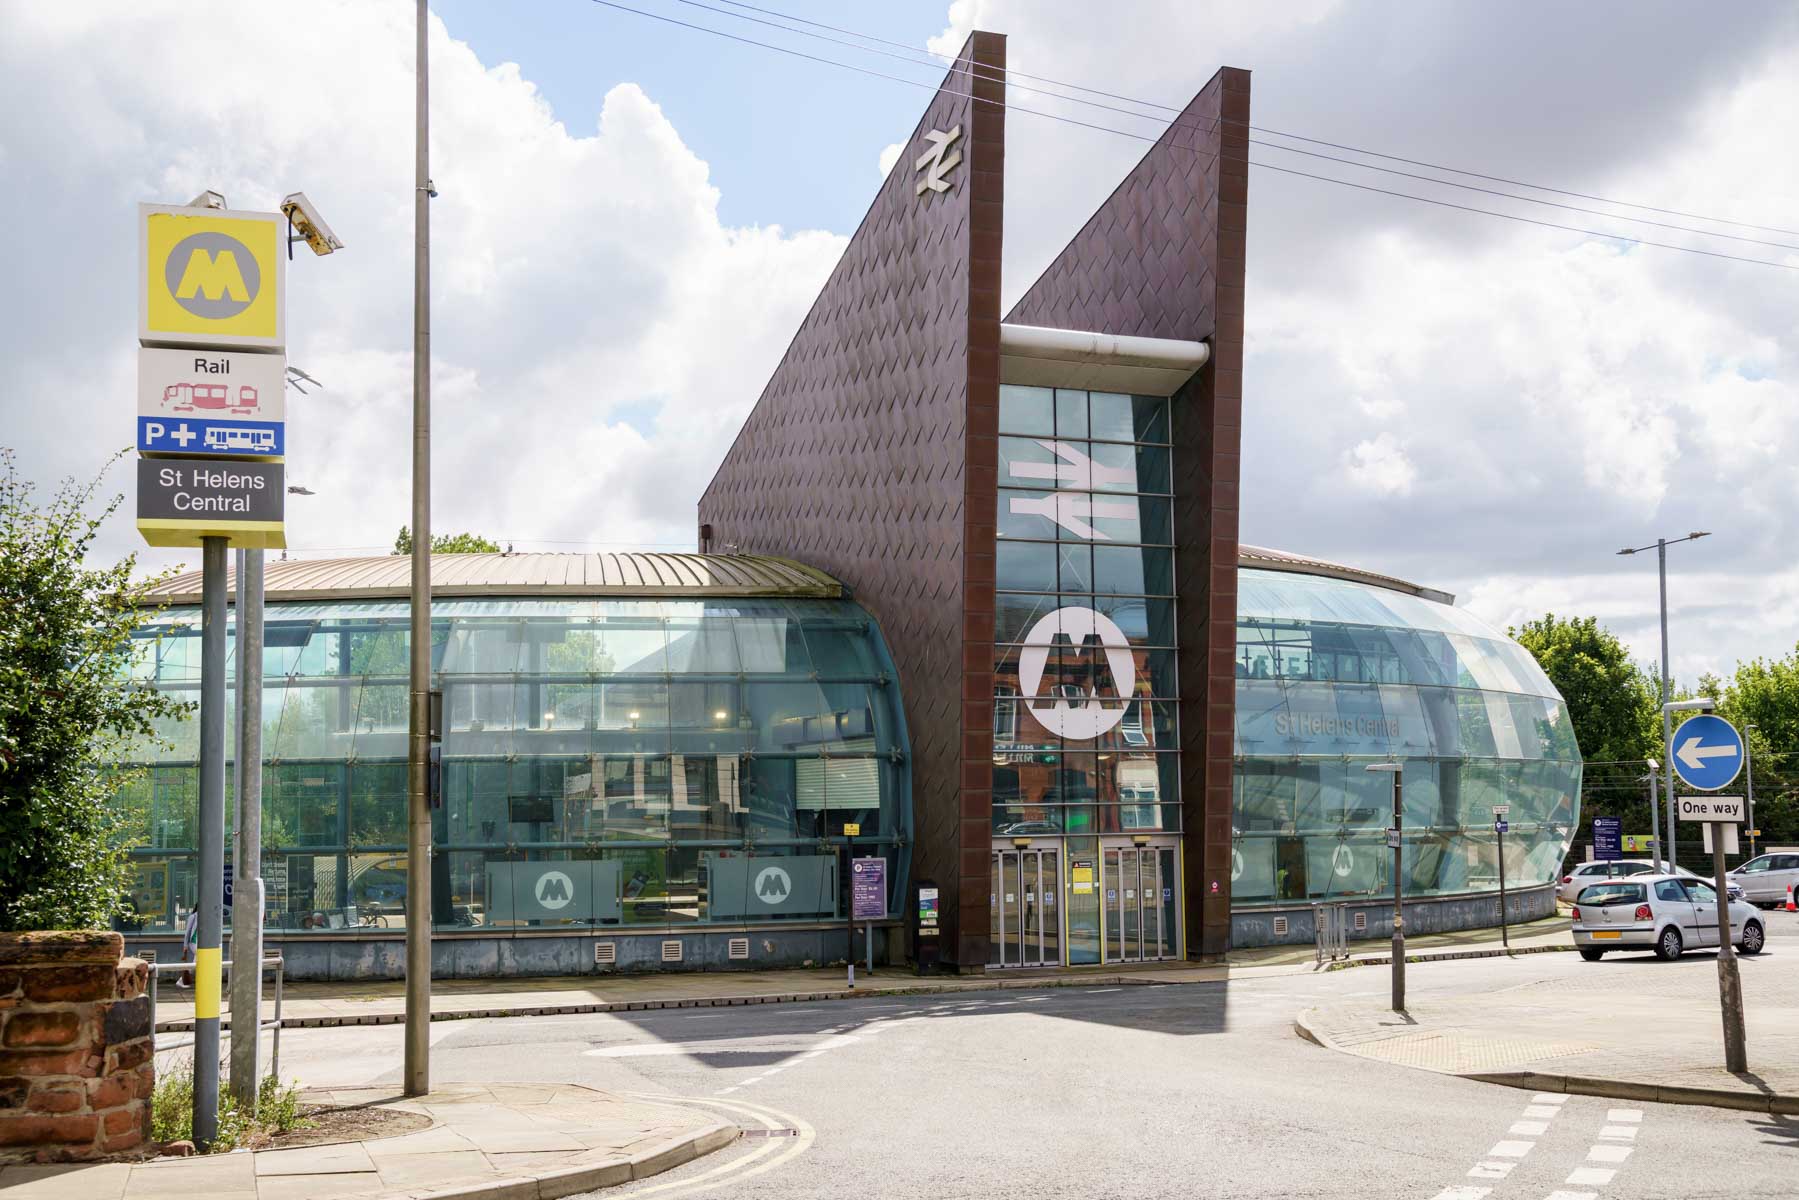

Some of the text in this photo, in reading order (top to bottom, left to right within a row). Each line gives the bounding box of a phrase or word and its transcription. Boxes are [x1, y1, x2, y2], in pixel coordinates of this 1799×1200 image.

[194, 358, 230, 374] Rail
[159, 468, 265, 489] St Helens
[173, 492, 250, 512] Central
[1274, 711, 1295, 736] St
[1298, 712, 1353, 737] Helens
[1682, 801, 1739, 816] One way
